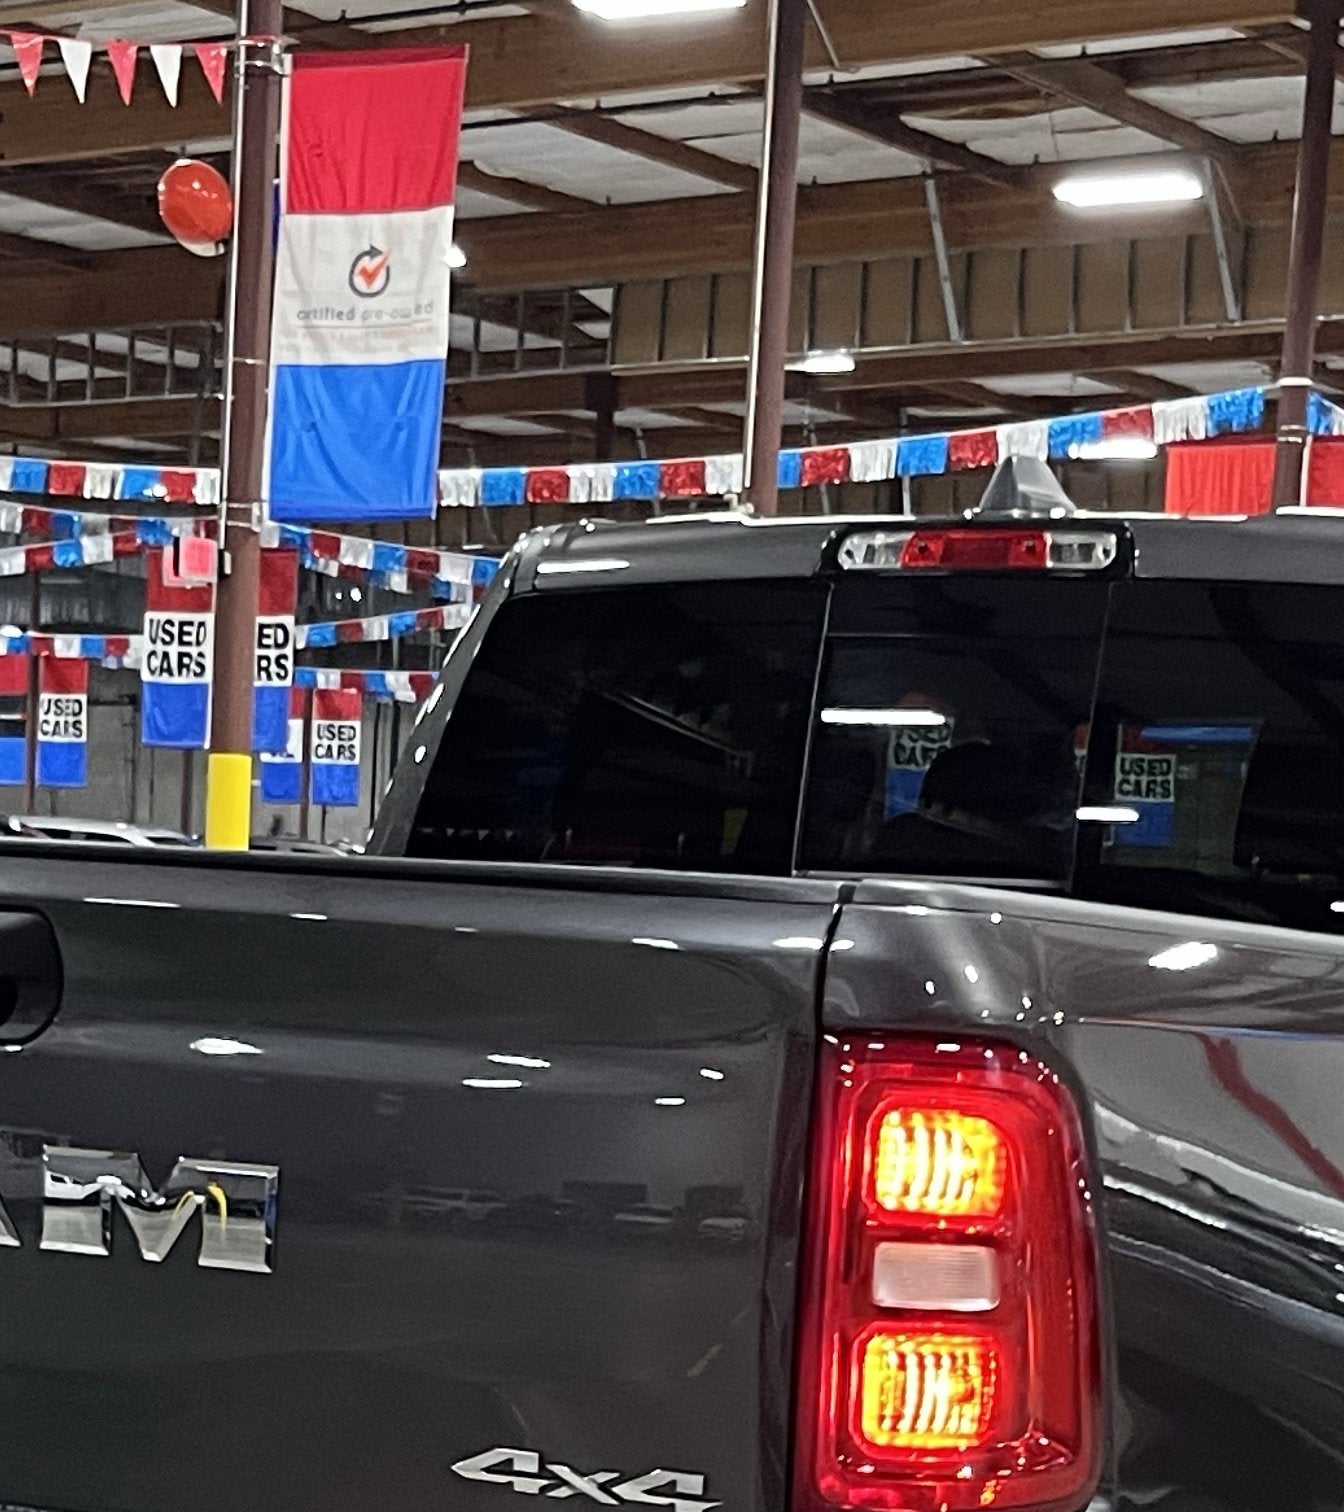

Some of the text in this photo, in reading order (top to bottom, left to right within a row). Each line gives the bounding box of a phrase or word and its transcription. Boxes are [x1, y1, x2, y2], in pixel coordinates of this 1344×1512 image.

[148, 619, 208, 648] USED
[258, 622, 290, 650] ED
[146, 651, 207, 679] CARS
[256, 653, 290, 682] RS
[42, 697, 84, 718] USED
[39, 719, 84, 739] CARS
[316, 723, 357, 742] USED
[314, 743, 357, 762] CARS
[1119, 756, 1172, 777] USED
[1117, 778, 1172, 799] CARS
